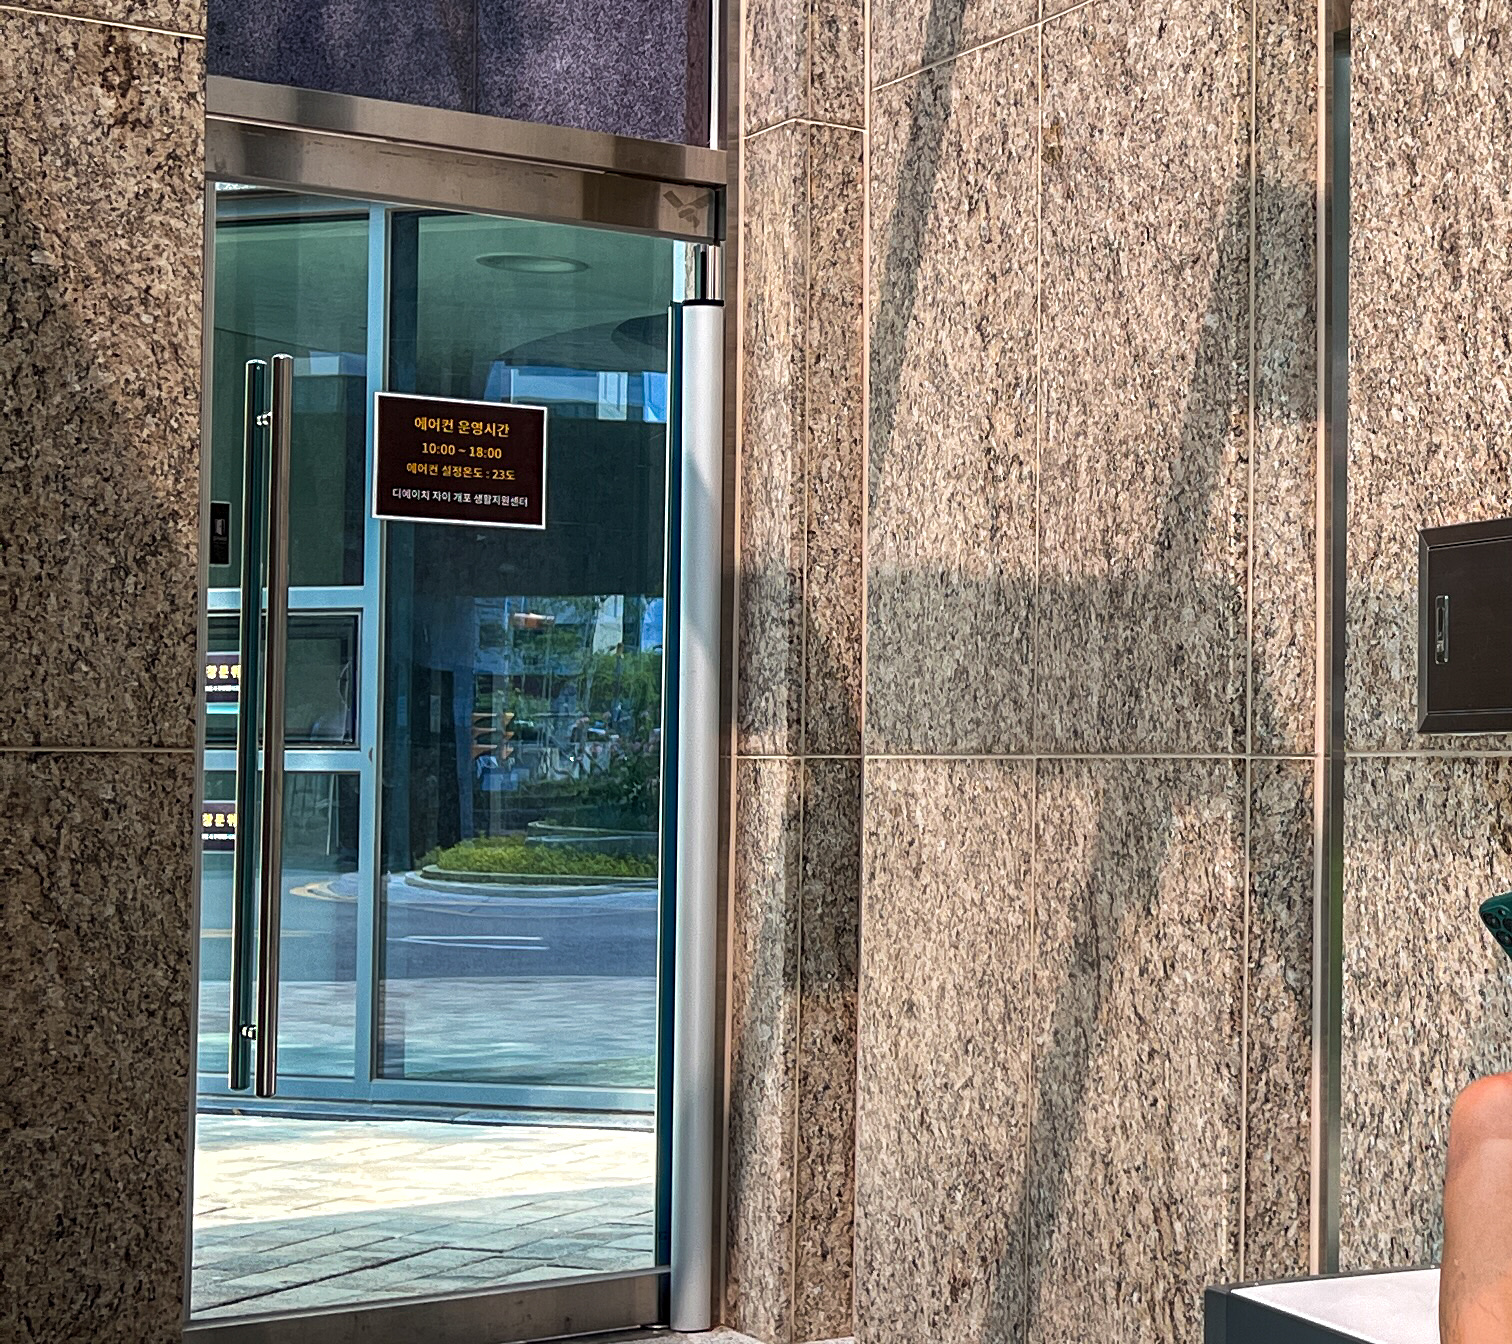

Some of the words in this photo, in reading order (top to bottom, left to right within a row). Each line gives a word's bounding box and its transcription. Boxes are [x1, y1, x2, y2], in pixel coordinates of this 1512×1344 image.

[414, 417, 454, 433] 에어컨
[458, 421, 510, 438] 운영시간
[421, 442, 456, 456] 10:00
[469, 446, 502, 459] 18:00
[406, 462, 439, 476] 에어컨
[441, 465, 484, 479] 설정온도
[492, 469, 516, 481] 23도
[392, 487, 430, 501] 디에이치
[432, 490, 451, 502] 자이
[453, 491, 472, 504] 개포
[473, 493, 529, 508] 생활지원센터
